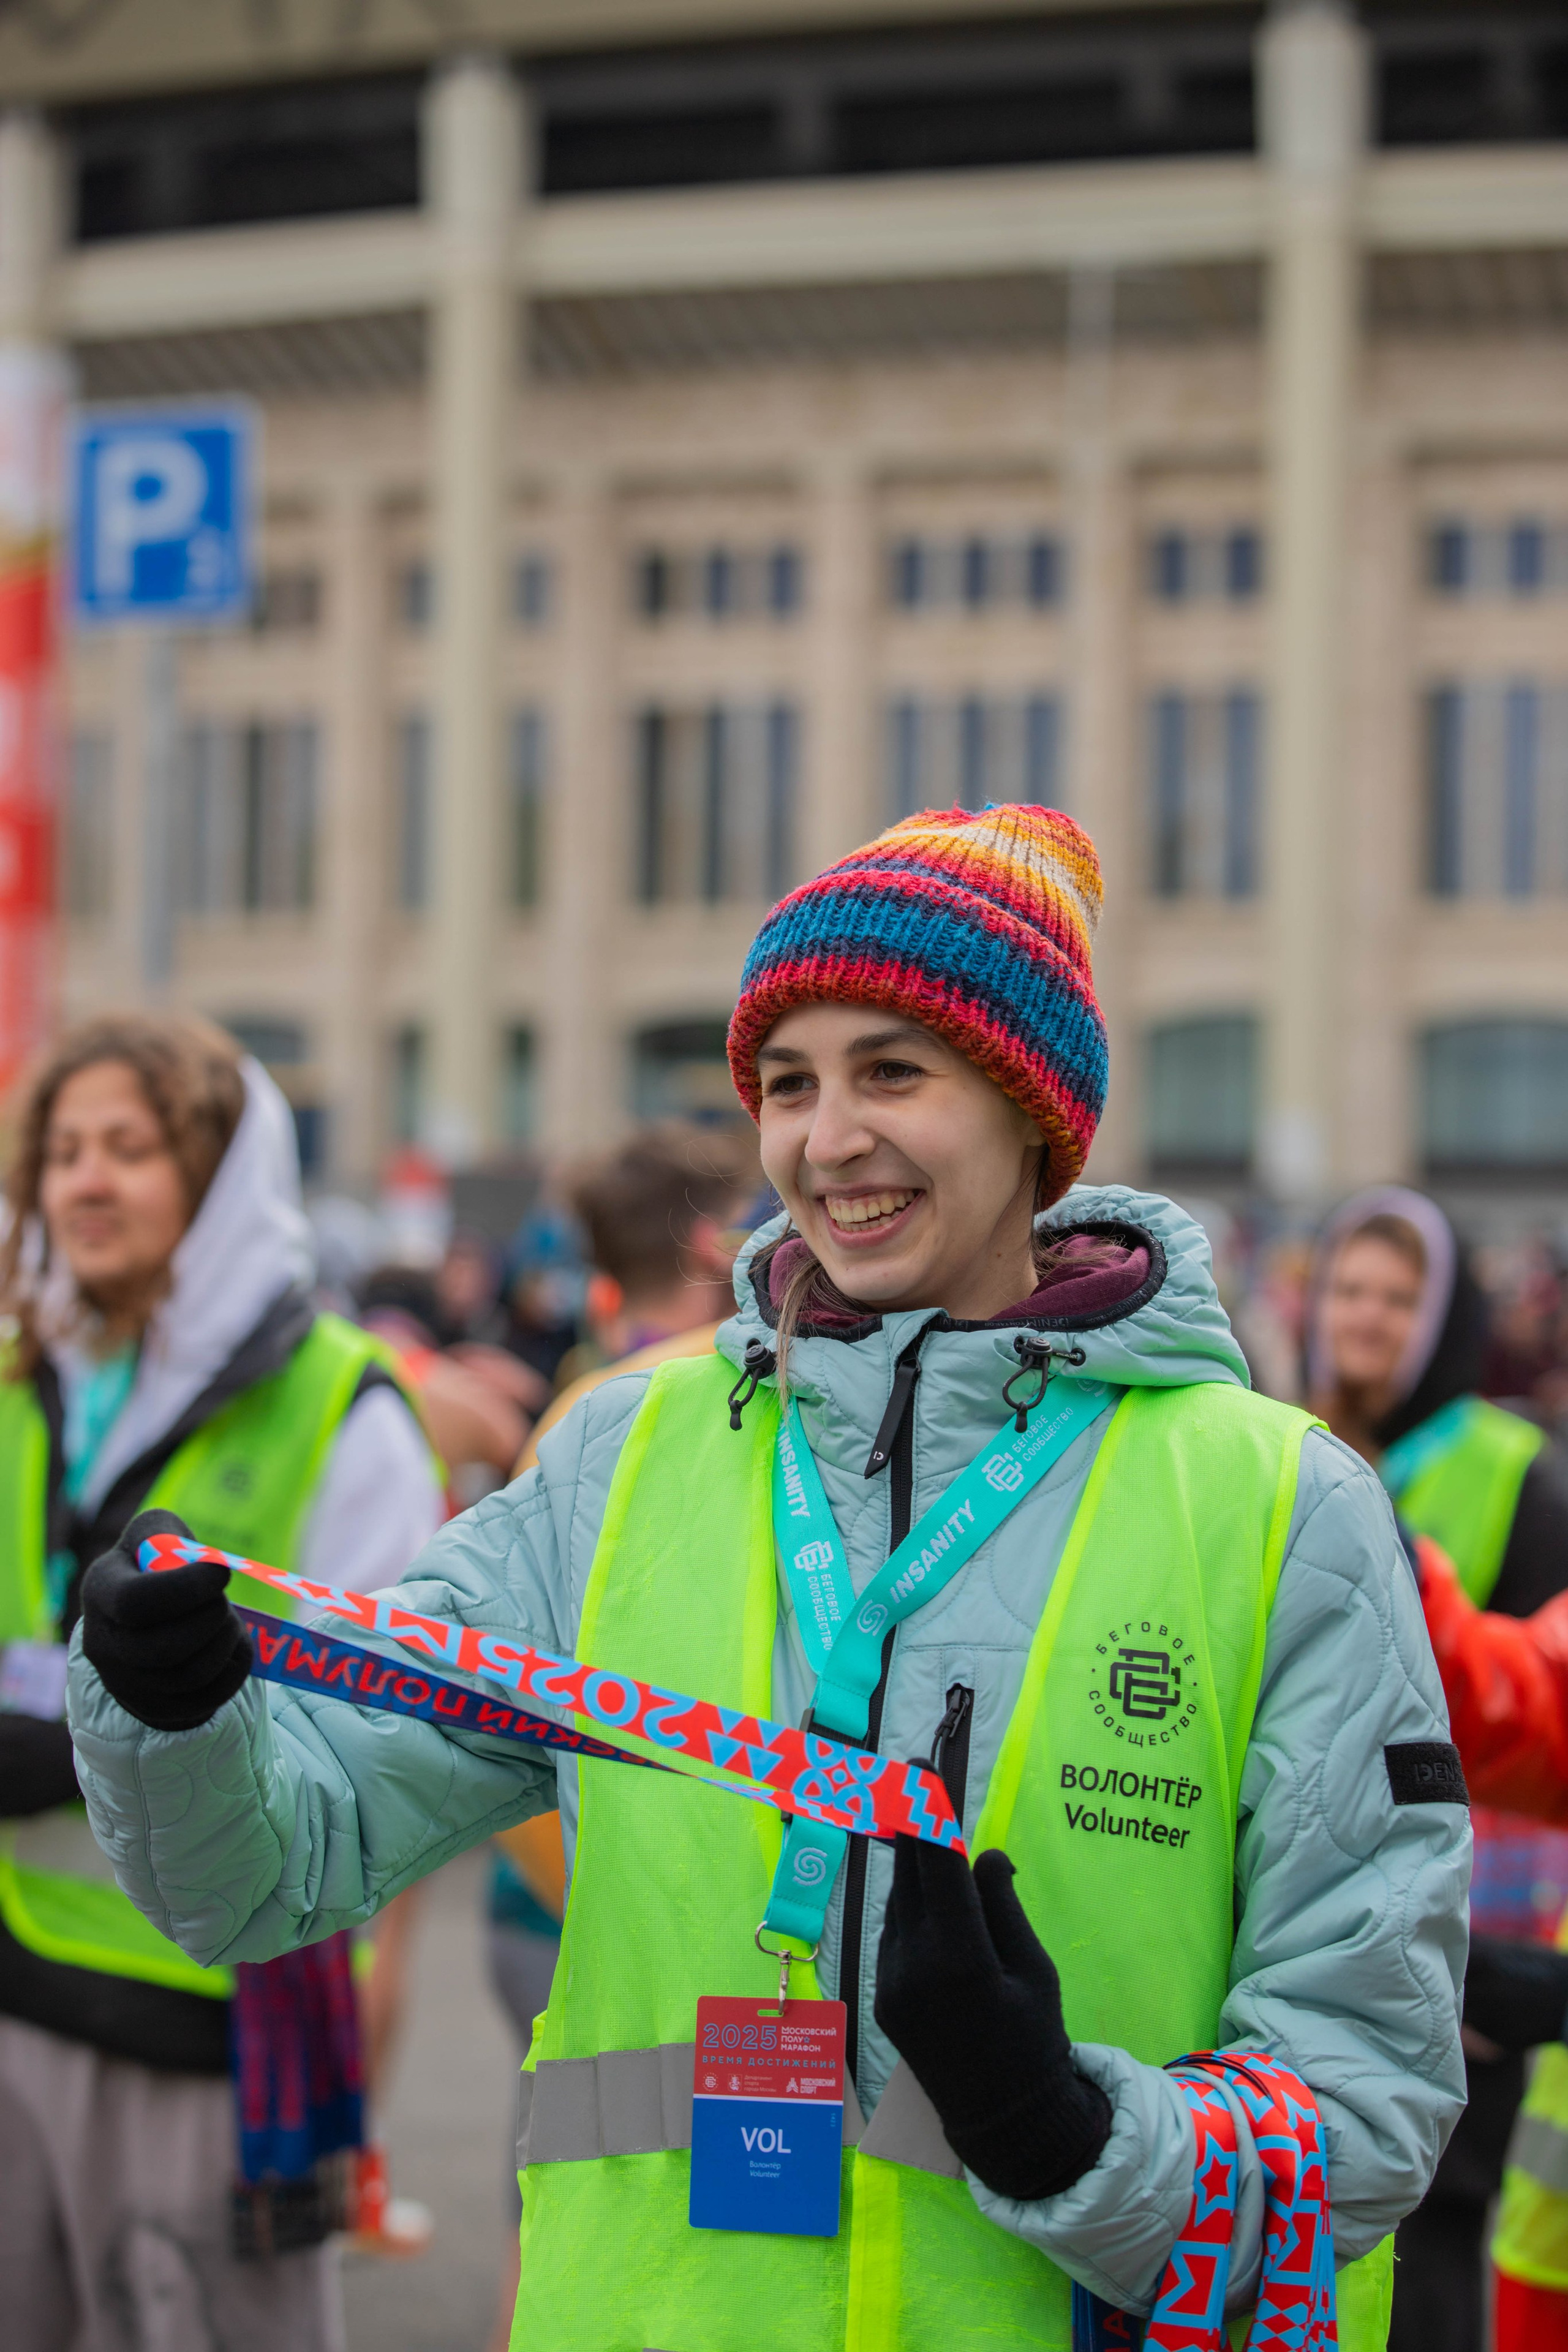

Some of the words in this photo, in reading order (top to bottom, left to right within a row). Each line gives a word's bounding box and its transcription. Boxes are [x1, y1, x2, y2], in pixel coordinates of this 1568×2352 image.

[1012, 1414, 1049, 1453] БЕГОВОЕ
[1022, 1407, 1074, 1461] СООБЩЕСТВО
[778, 1430, 810, 1517] INSANITY
[889, 1498, 975, 1604] INSANITY
[821, 1574, 842, 1622] БЕГОВОЕ
[1095, 1621, 1196, 1665] БЕГОВОЕ
[477, 1634, 698, 1749] 2025
[1088, 1689, 1197, 1748] СООБЩЕСТВО
[1060, 1764, 1202, 1809] ВОЛОНТЁР
[1065, 1803, 1191, 1849] Volunteer
[702, 2023, 778, 2051] 2025
[780, 2044, 821, 2052] МАРАФОН
[781, 2026, 837, 2037] МОСКОВСКИЙ
[702, 2055, 742, 2065] ВРЕМЯ
[748, 2057, 836, 2068] ДОСТИЖЕНИЙ
[741, 2127, 791, 2154] VOL
[749, 2160, 782, 2170] Волонтёр
[749, 2169, 781, 2178] Volunteer
